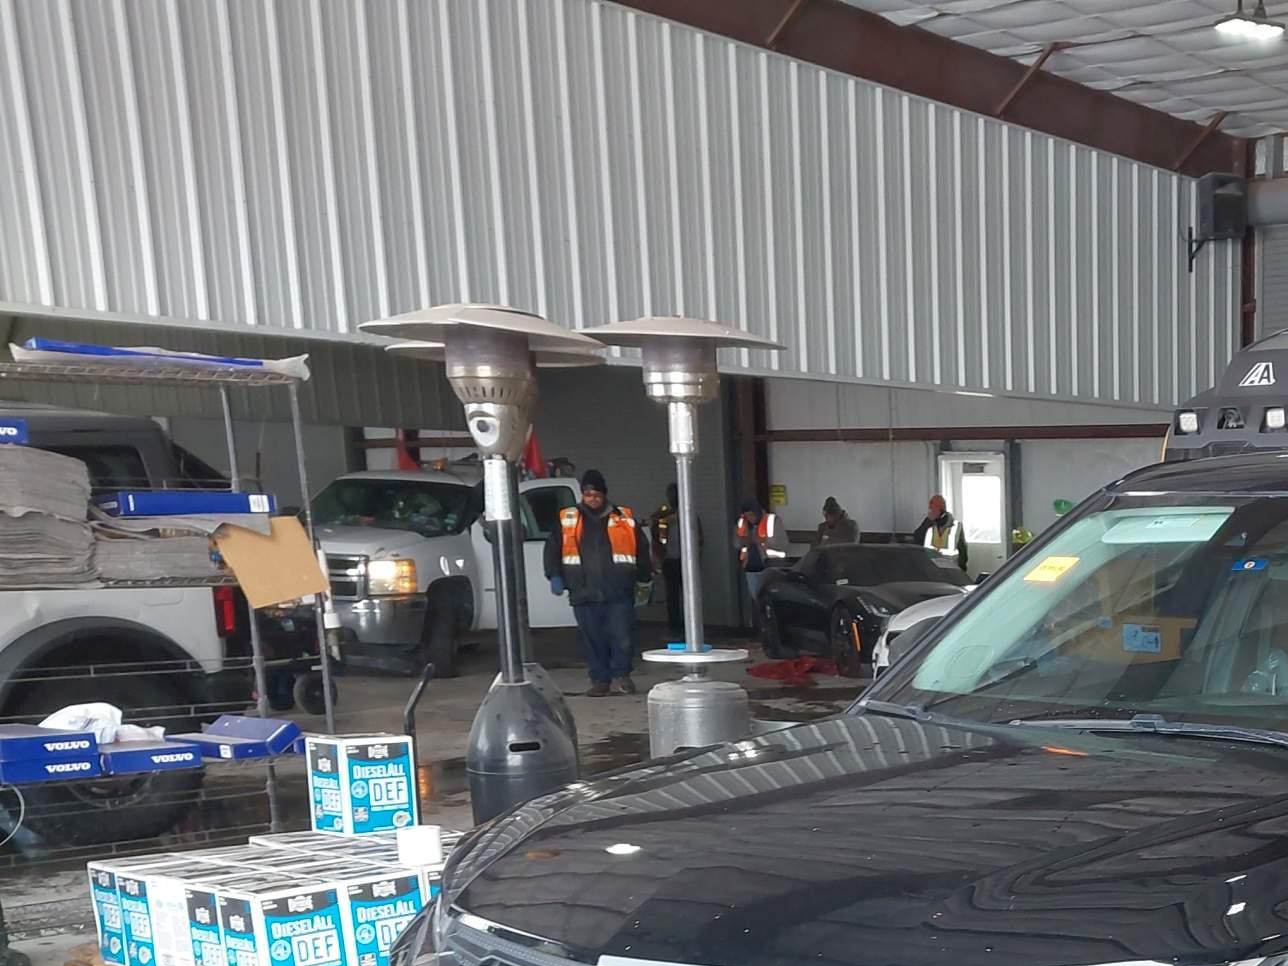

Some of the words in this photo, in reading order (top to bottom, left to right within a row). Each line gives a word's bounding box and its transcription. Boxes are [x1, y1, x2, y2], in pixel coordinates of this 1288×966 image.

[43, 740, 90, 752] VOLVO
[151, 752, 194, 764] VOLVO
[44, 761, 92, 773] VOLVO
[373, 780, 404, 802] DEF
[297, 934, 335, 962] DEF
